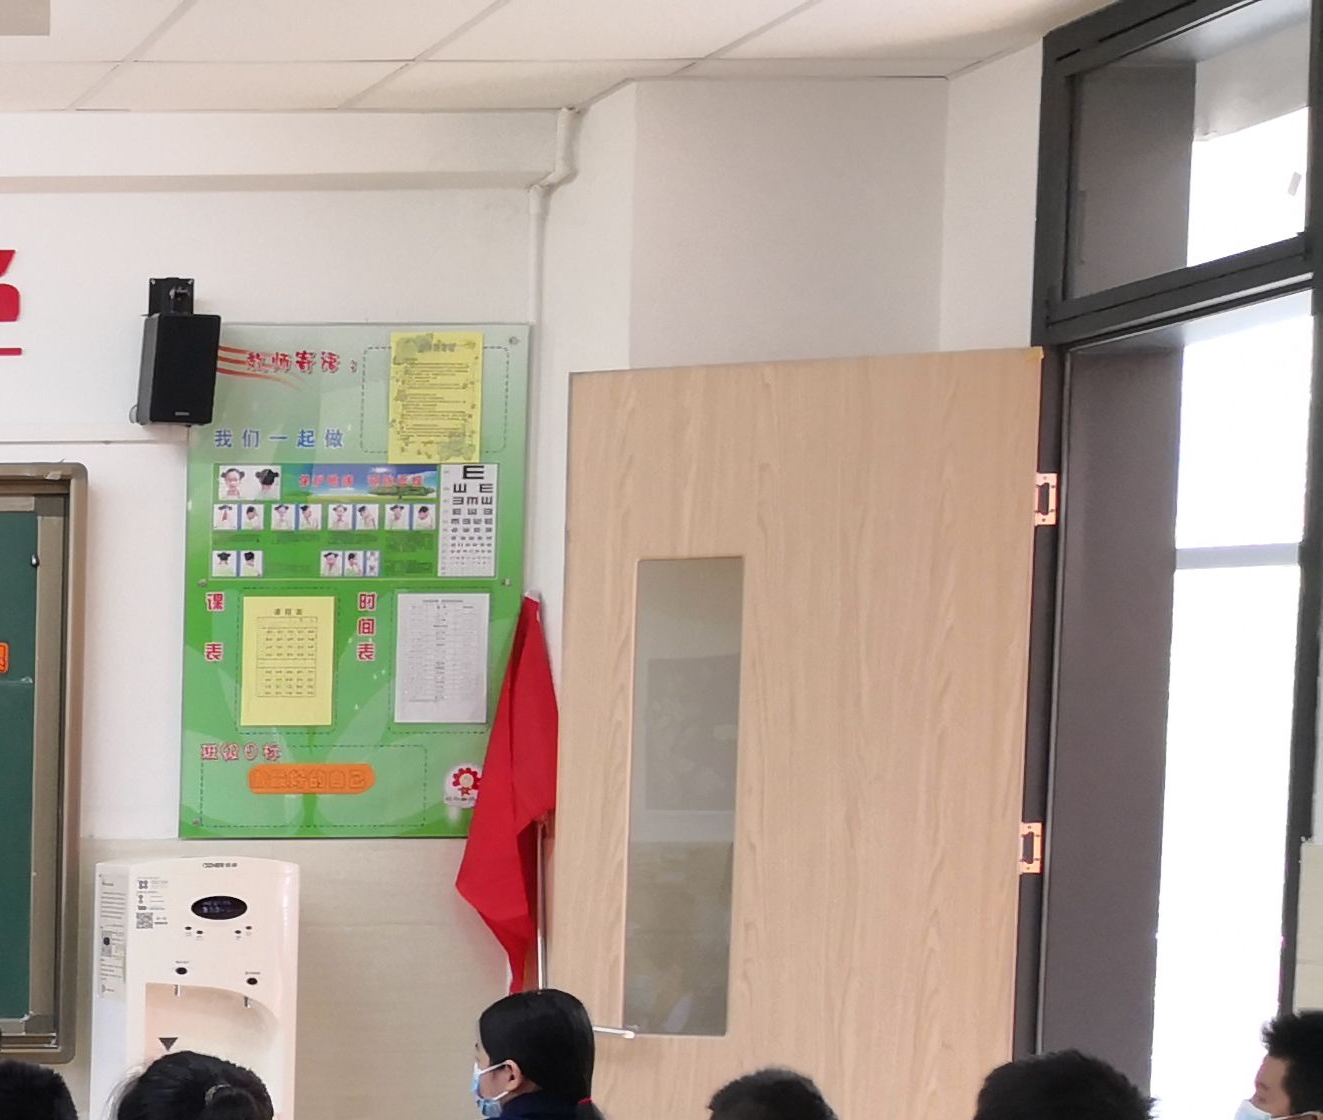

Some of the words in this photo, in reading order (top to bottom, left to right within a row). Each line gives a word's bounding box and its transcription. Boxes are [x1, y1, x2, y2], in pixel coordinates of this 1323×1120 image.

[214, 428, 343, 448] 我们一起做
[358, 592, 376, 660] 时间表
